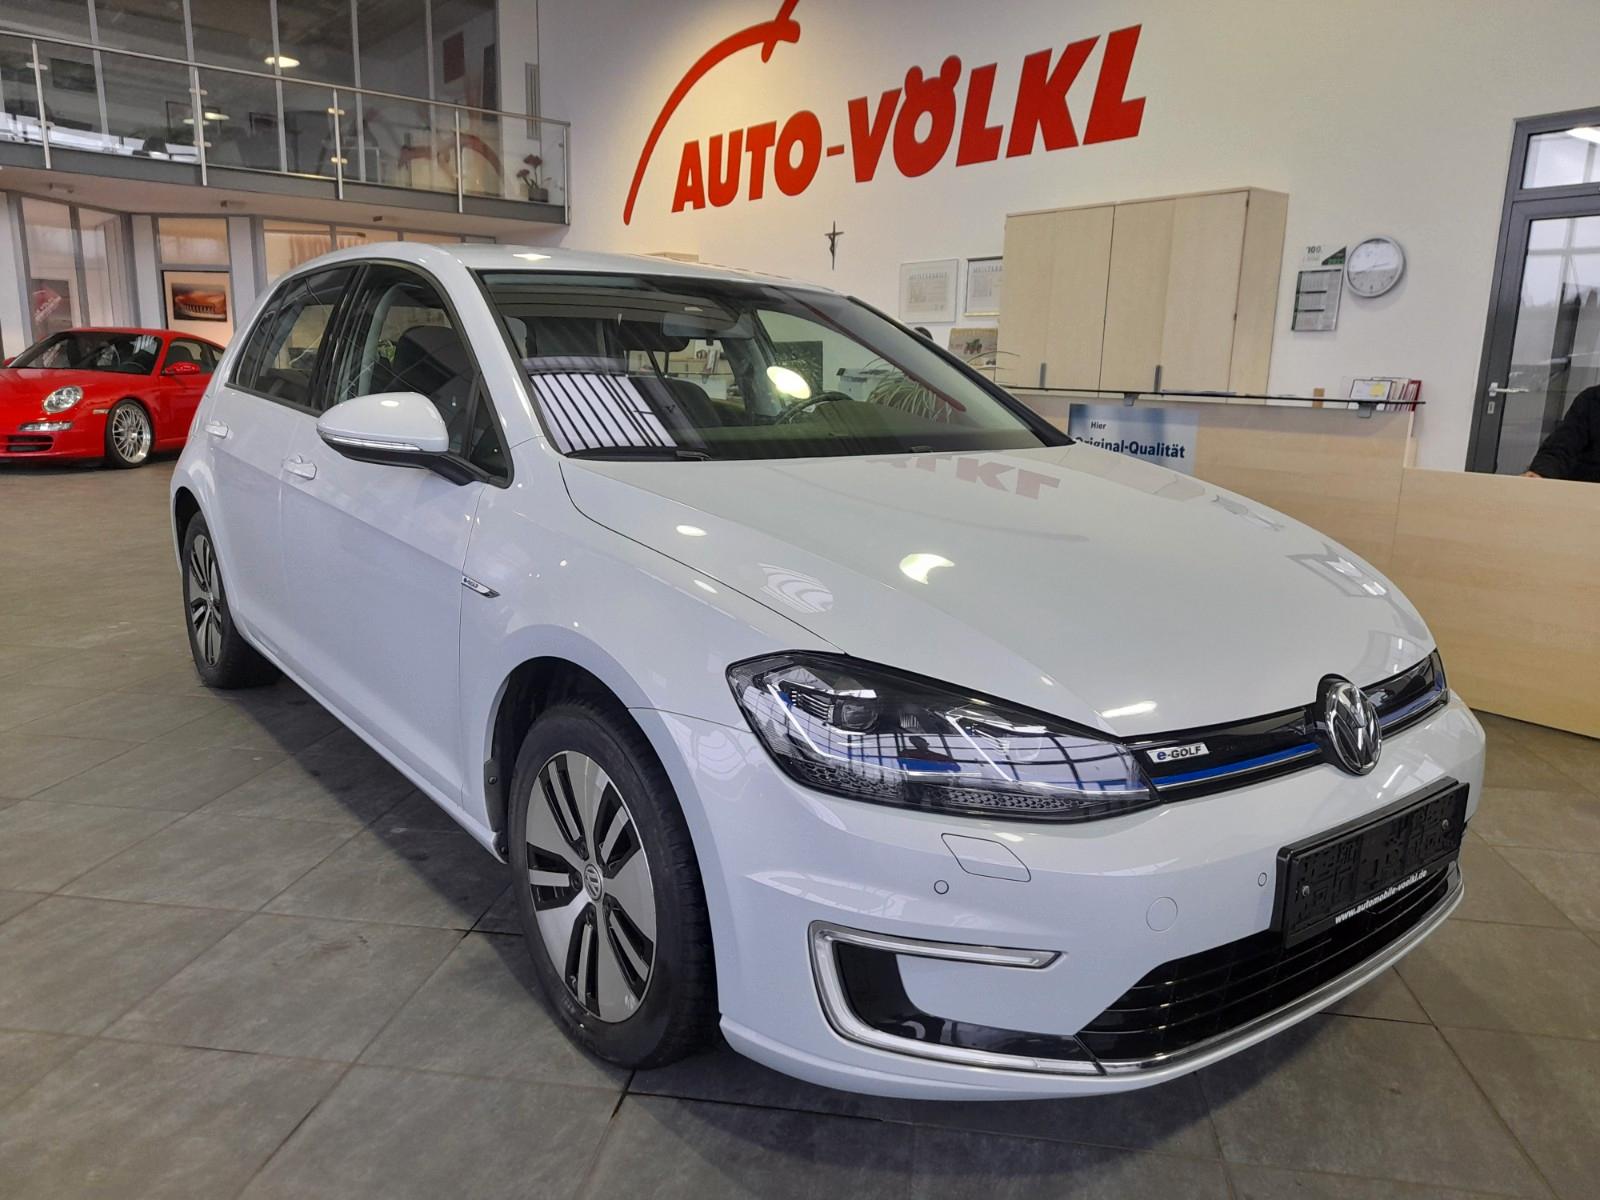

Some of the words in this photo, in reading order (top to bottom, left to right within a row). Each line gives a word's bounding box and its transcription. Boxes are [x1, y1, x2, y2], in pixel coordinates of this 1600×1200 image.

[671, 23, 1147, 213] AUTO-VÖLKL
[1090, 420, 1107, 430] Hier
[1156, 745, 1202, 761] e-GOLF
[1335, 869, 1428, 924] www.automobile-voelkl.de
